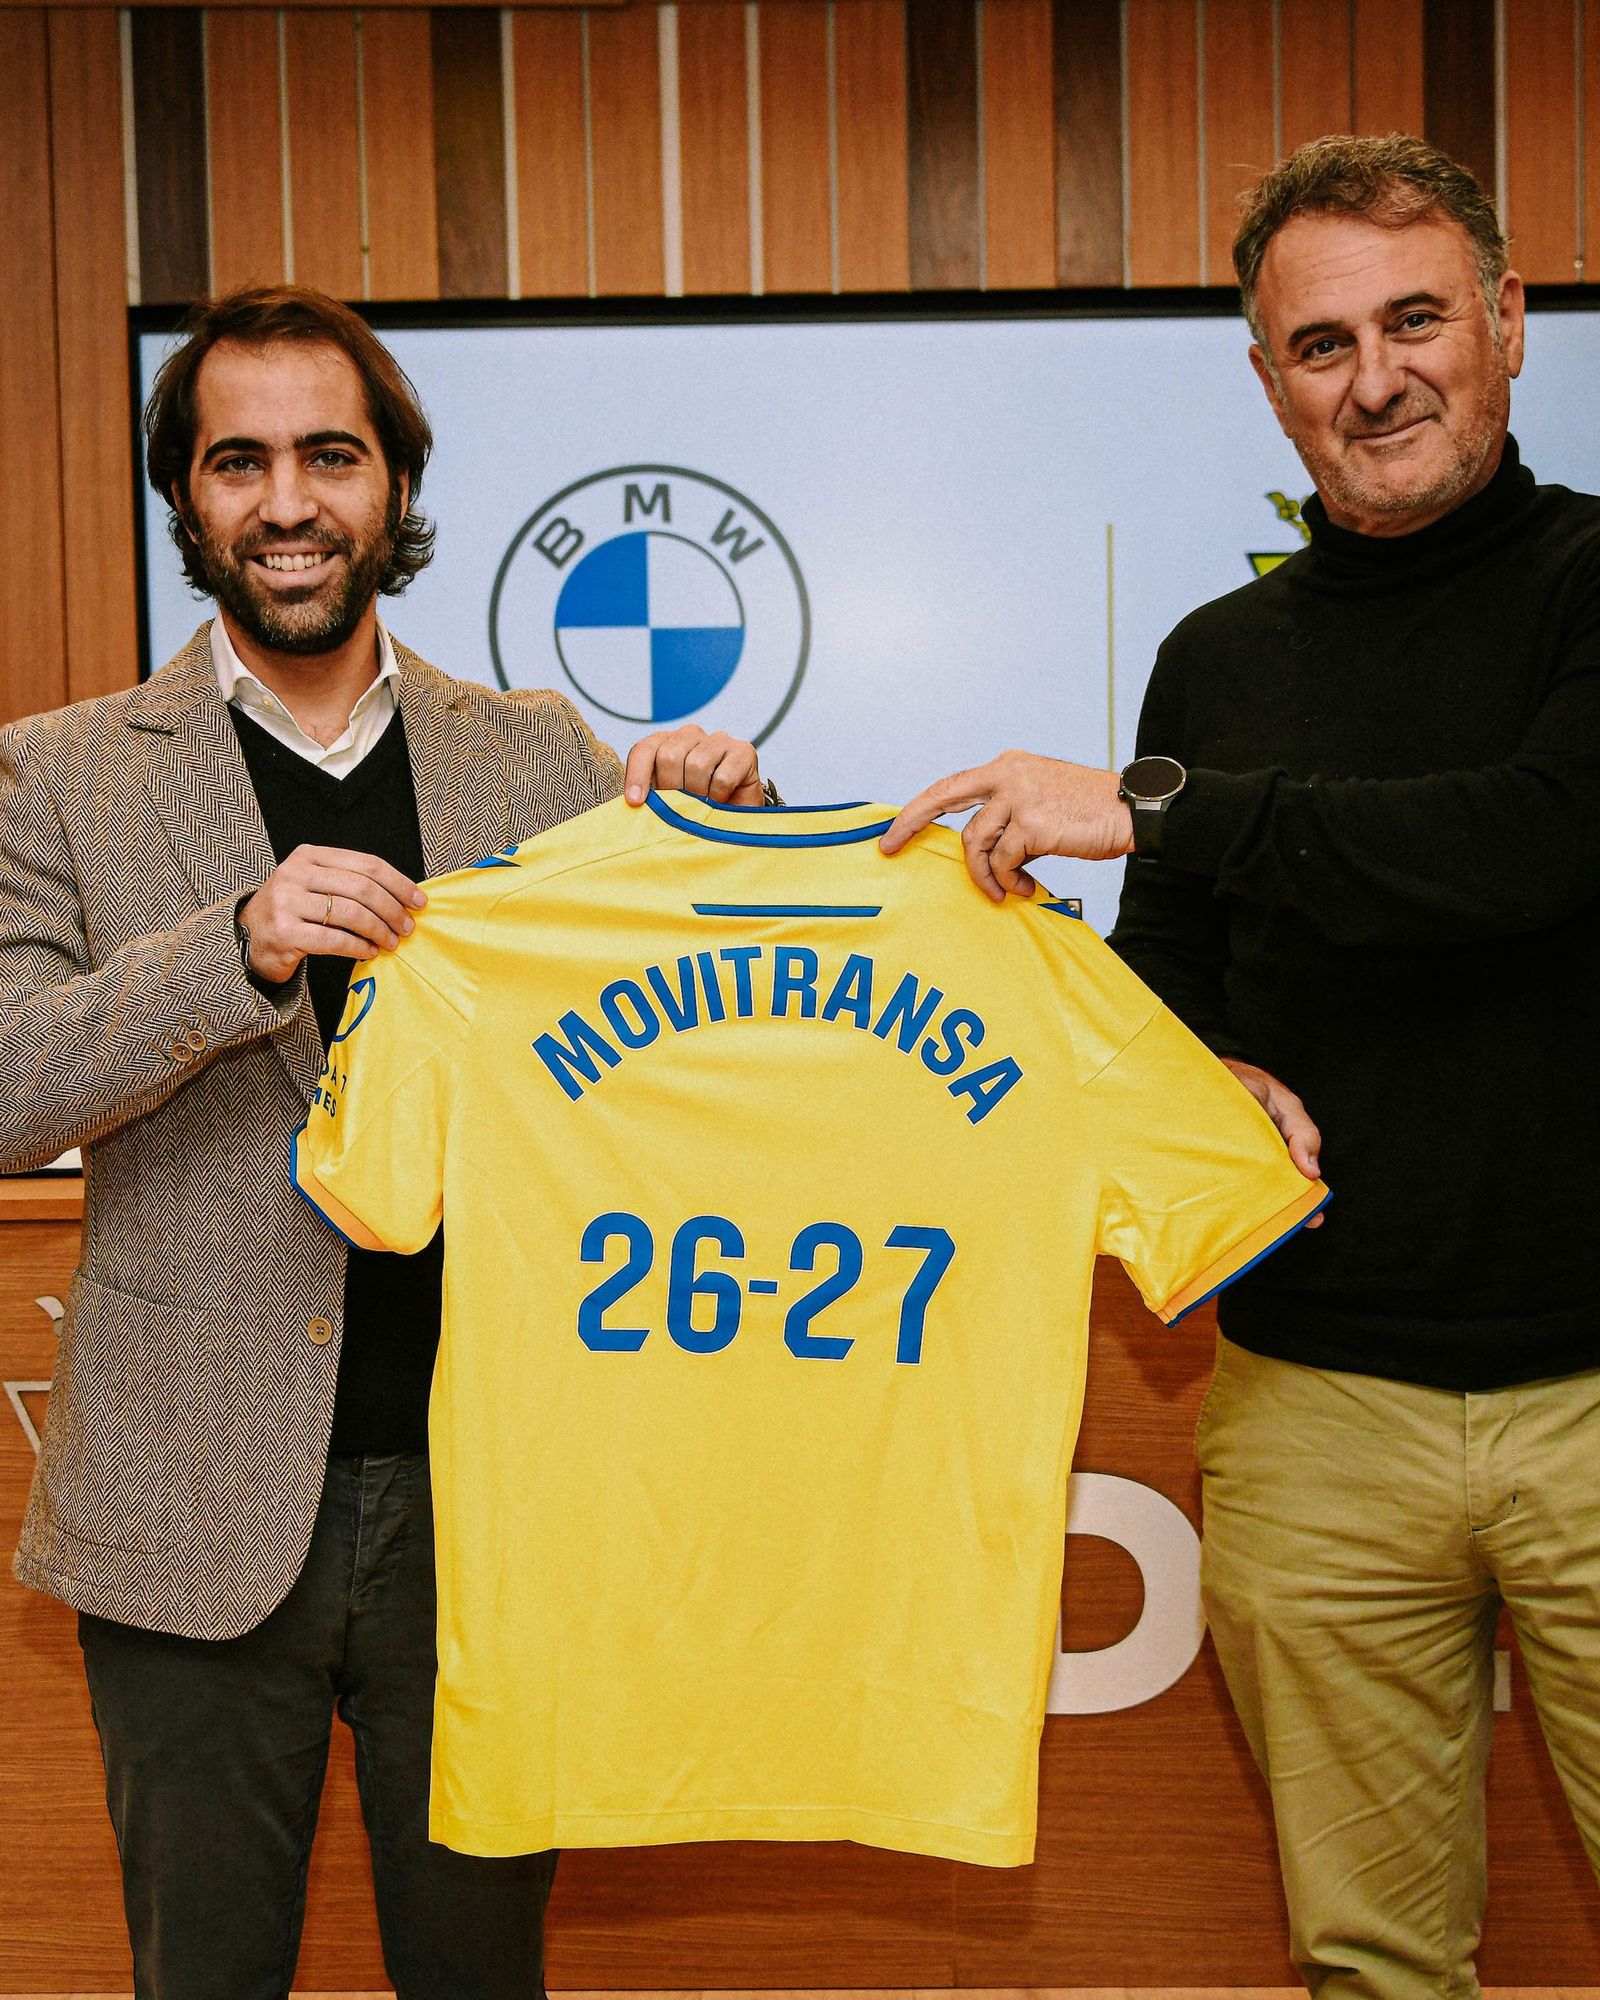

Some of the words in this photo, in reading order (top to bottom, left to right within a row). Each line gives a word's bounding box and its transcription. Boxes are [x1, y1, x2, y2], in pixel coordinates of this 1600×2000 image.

[533, 483, 766, 569] BMW
[531, 945, 1024, 1125] MOVITRANSA
[577, 1211, 956, 1366] 26-27
